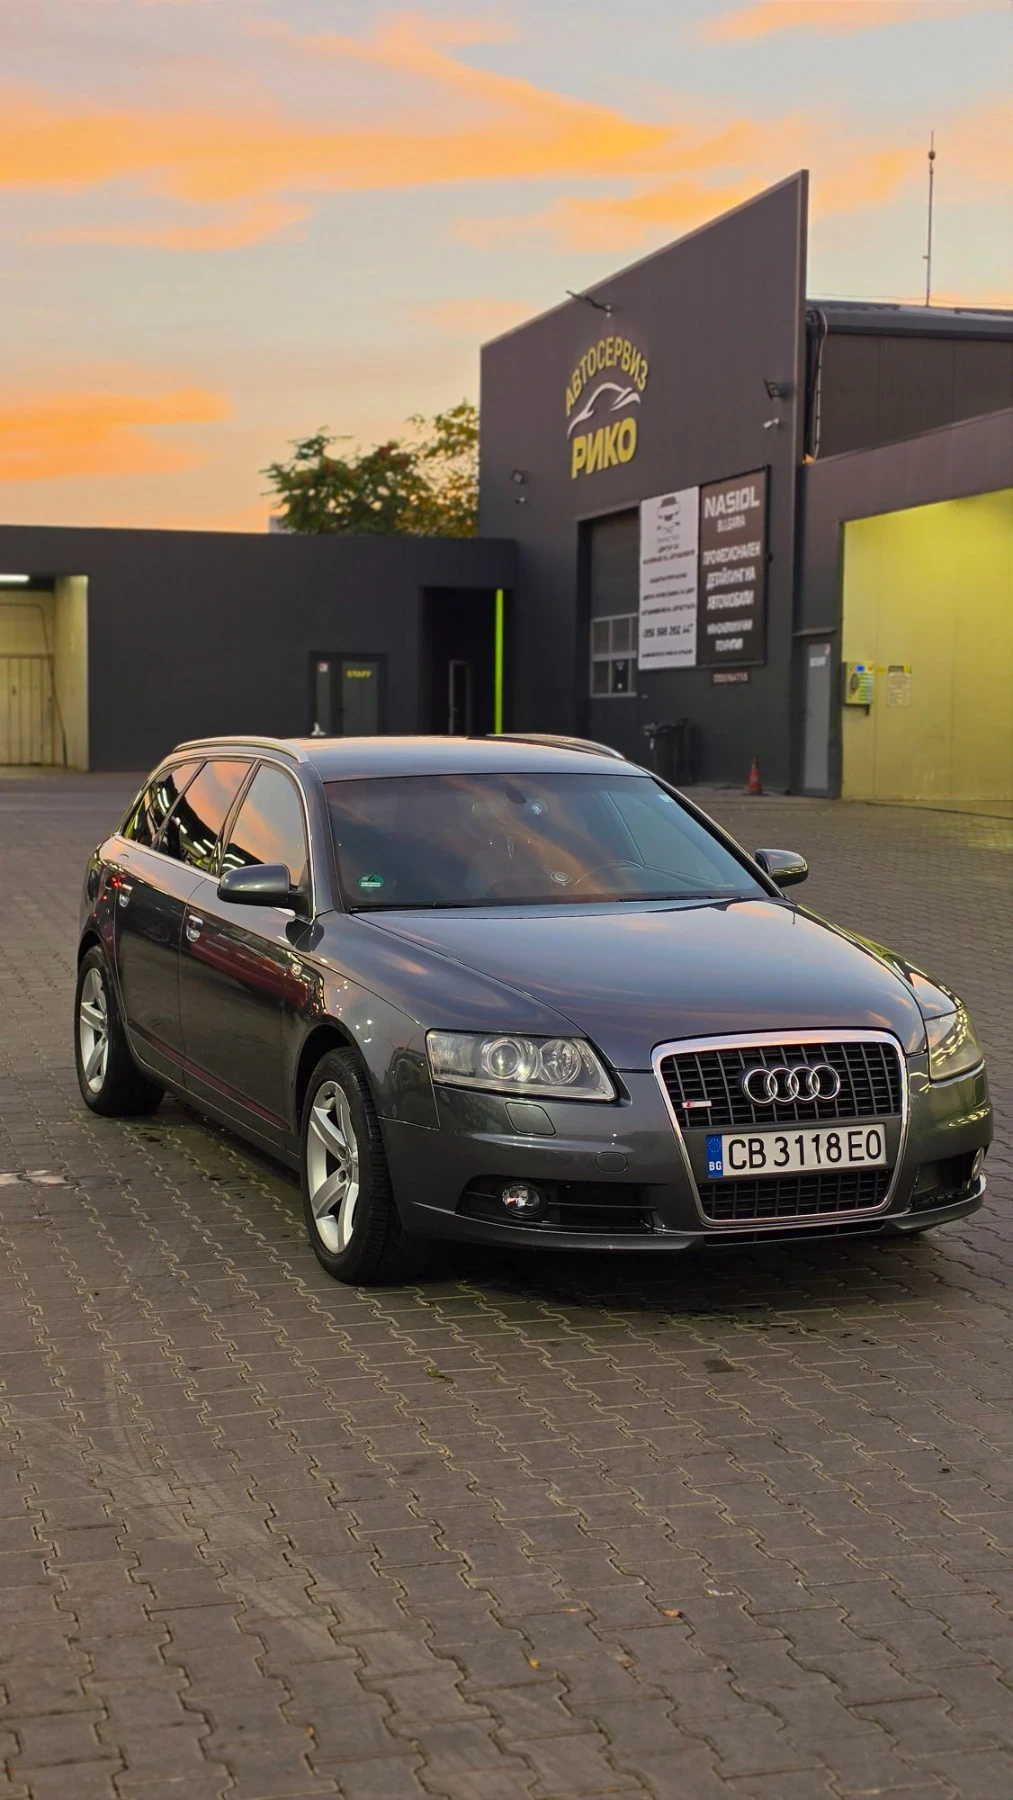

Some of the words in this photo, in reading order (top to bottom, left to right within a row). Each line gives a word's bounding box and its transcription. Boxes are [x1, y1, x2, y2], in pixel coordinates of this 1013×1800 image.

[565, 332, 649, 417] АВТОСЕРВИЗ
[571, 417, 637, 479] РИКО
[346, 669, 372, 678] STAFF
[708, 1160, 722, 1171] BG
[728, 1137, 767, 1170] CB
[773, 1131, 842, 1168] 3118
